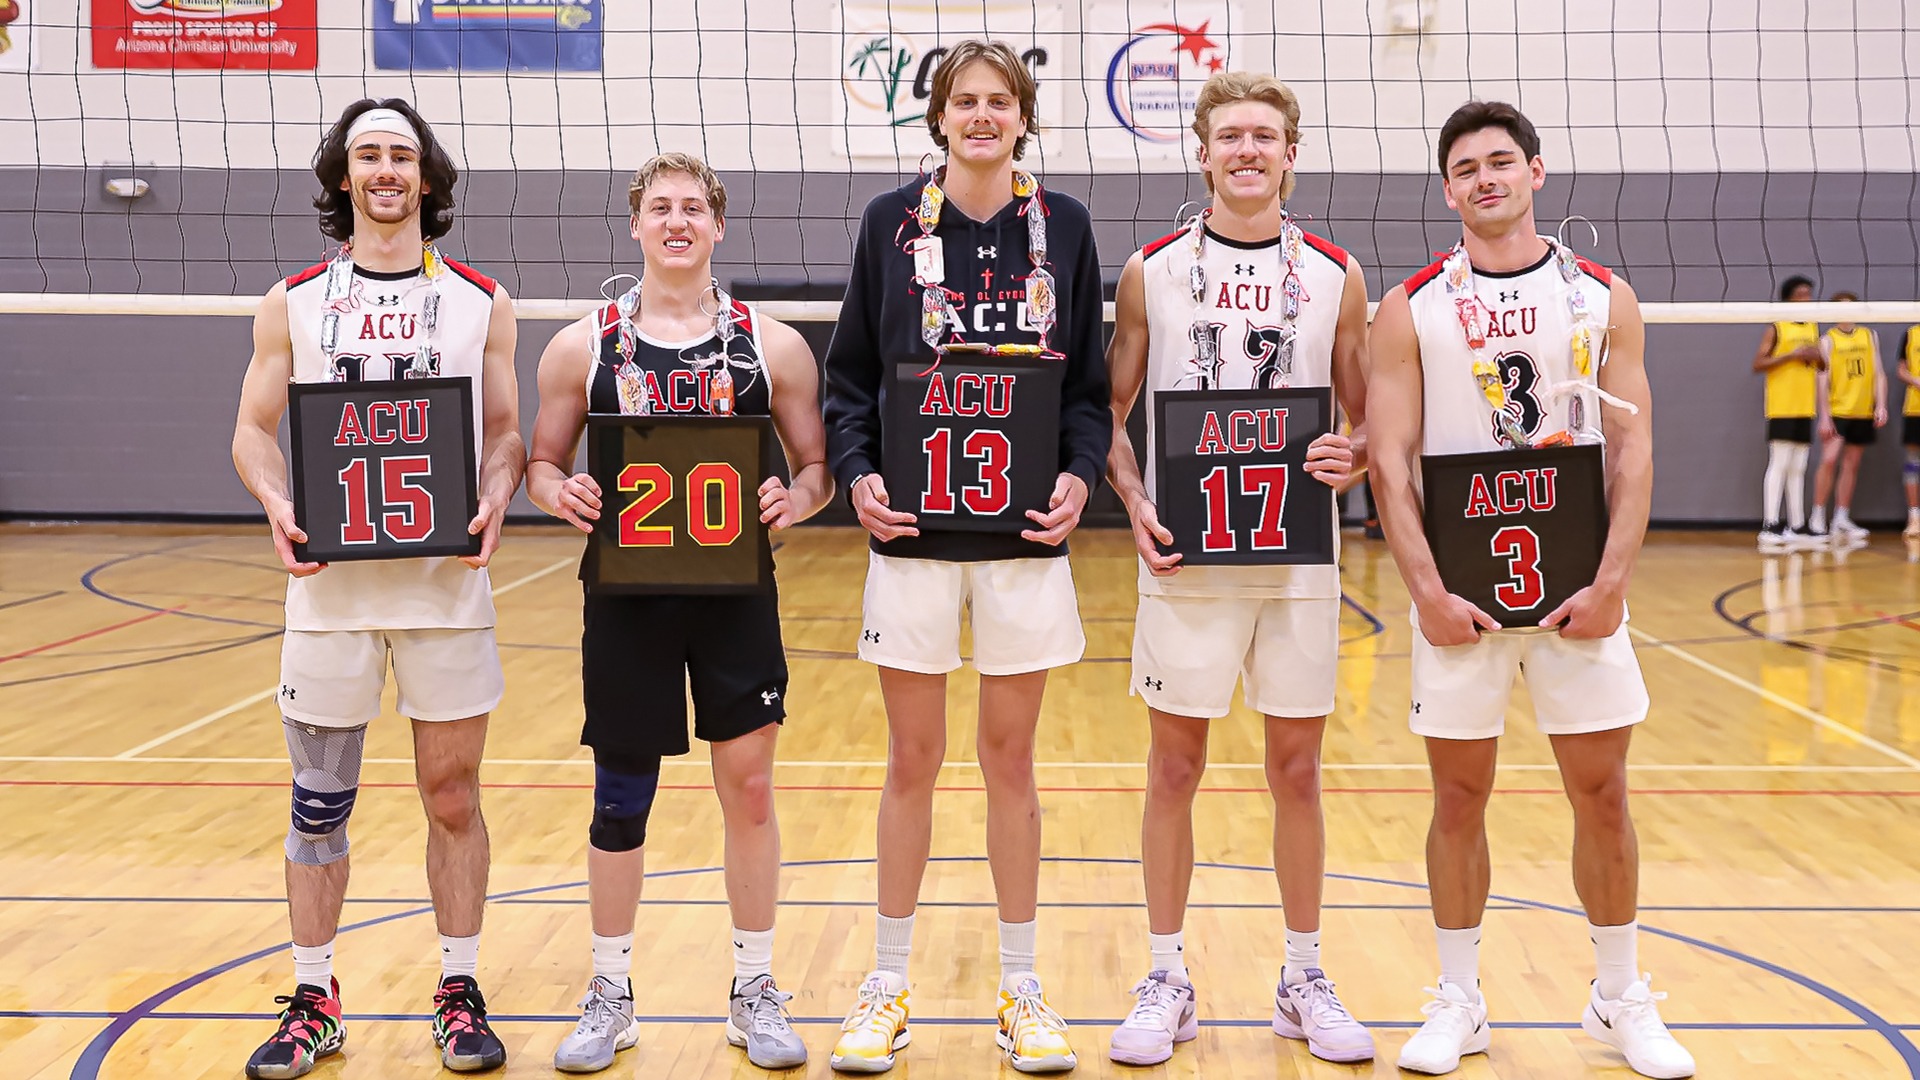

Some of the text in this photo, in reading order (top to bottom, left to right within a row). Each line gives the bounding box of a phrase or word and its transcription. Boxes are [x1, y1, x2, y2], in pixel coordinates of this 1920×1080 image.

[115, 37, 298, 56] Arizona Christian University
[132, 20, 278, 37] PROUD SPONSOR OF
[1216, 282, 1271, 312] ACU
[358, 313, 418, 340] ACU
[1486, 307, 1537, 338] ACU
[920, 371, 1016, 418] ACU
[1491, 351, 1547, 446] 3
[334, 399, 430, 446] ACU
[1196, 408, 1289, 455] ACU
[921, 428, 1012, 516] 13
[1465, 468, 1557, 518] ACU
[338, 454, 436, 545] 15
[617, 462, 742, 547] 20
[1200, 464, 1289, 553] 17
[1490, 525, 1545, 611] 3
